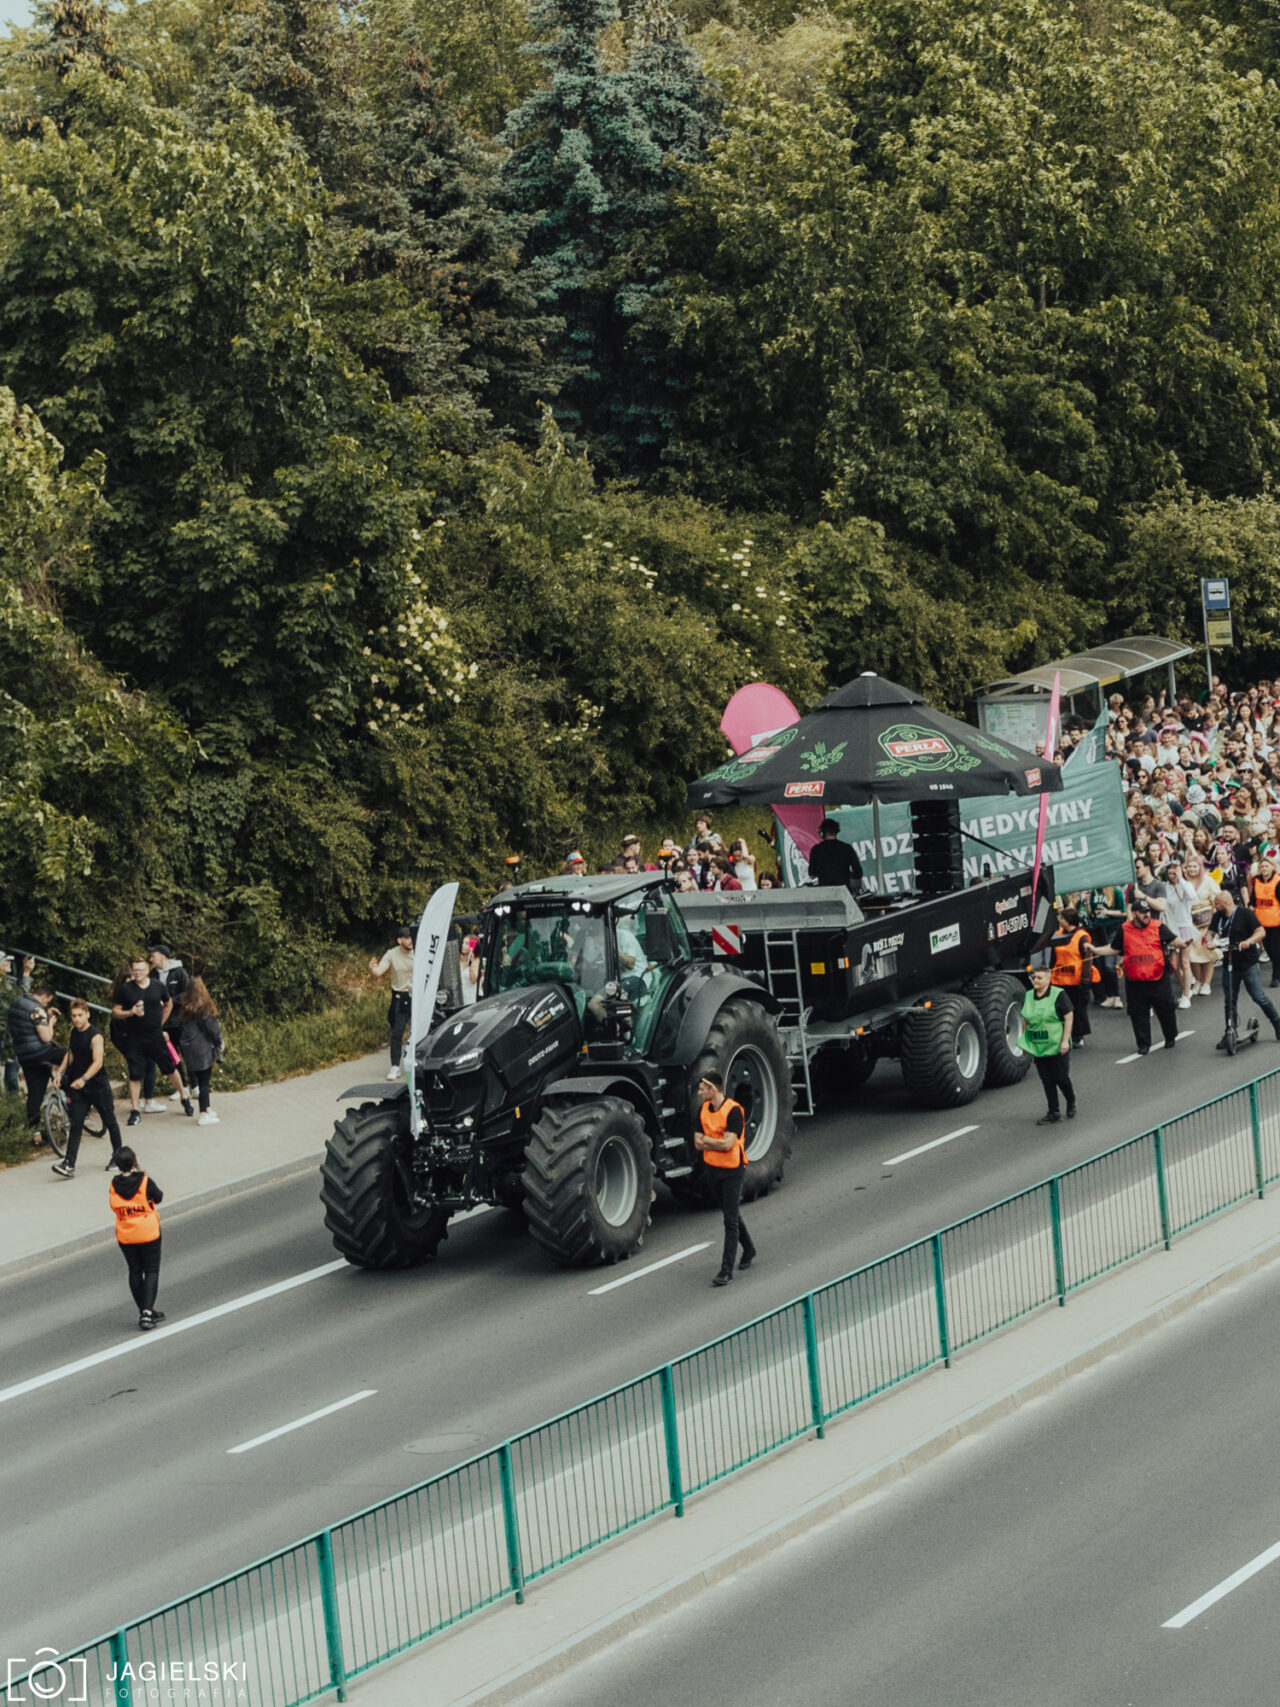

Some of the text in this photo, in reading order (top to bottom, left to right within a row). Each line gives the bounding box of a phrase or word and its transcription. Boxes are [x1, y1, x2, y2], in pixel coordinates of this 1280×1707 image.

[894, 740, 944, 755] PERŁA
[788, 783, 822, 795] PERŁA
[960, 798, 1094, 843] MEDYCYNY
